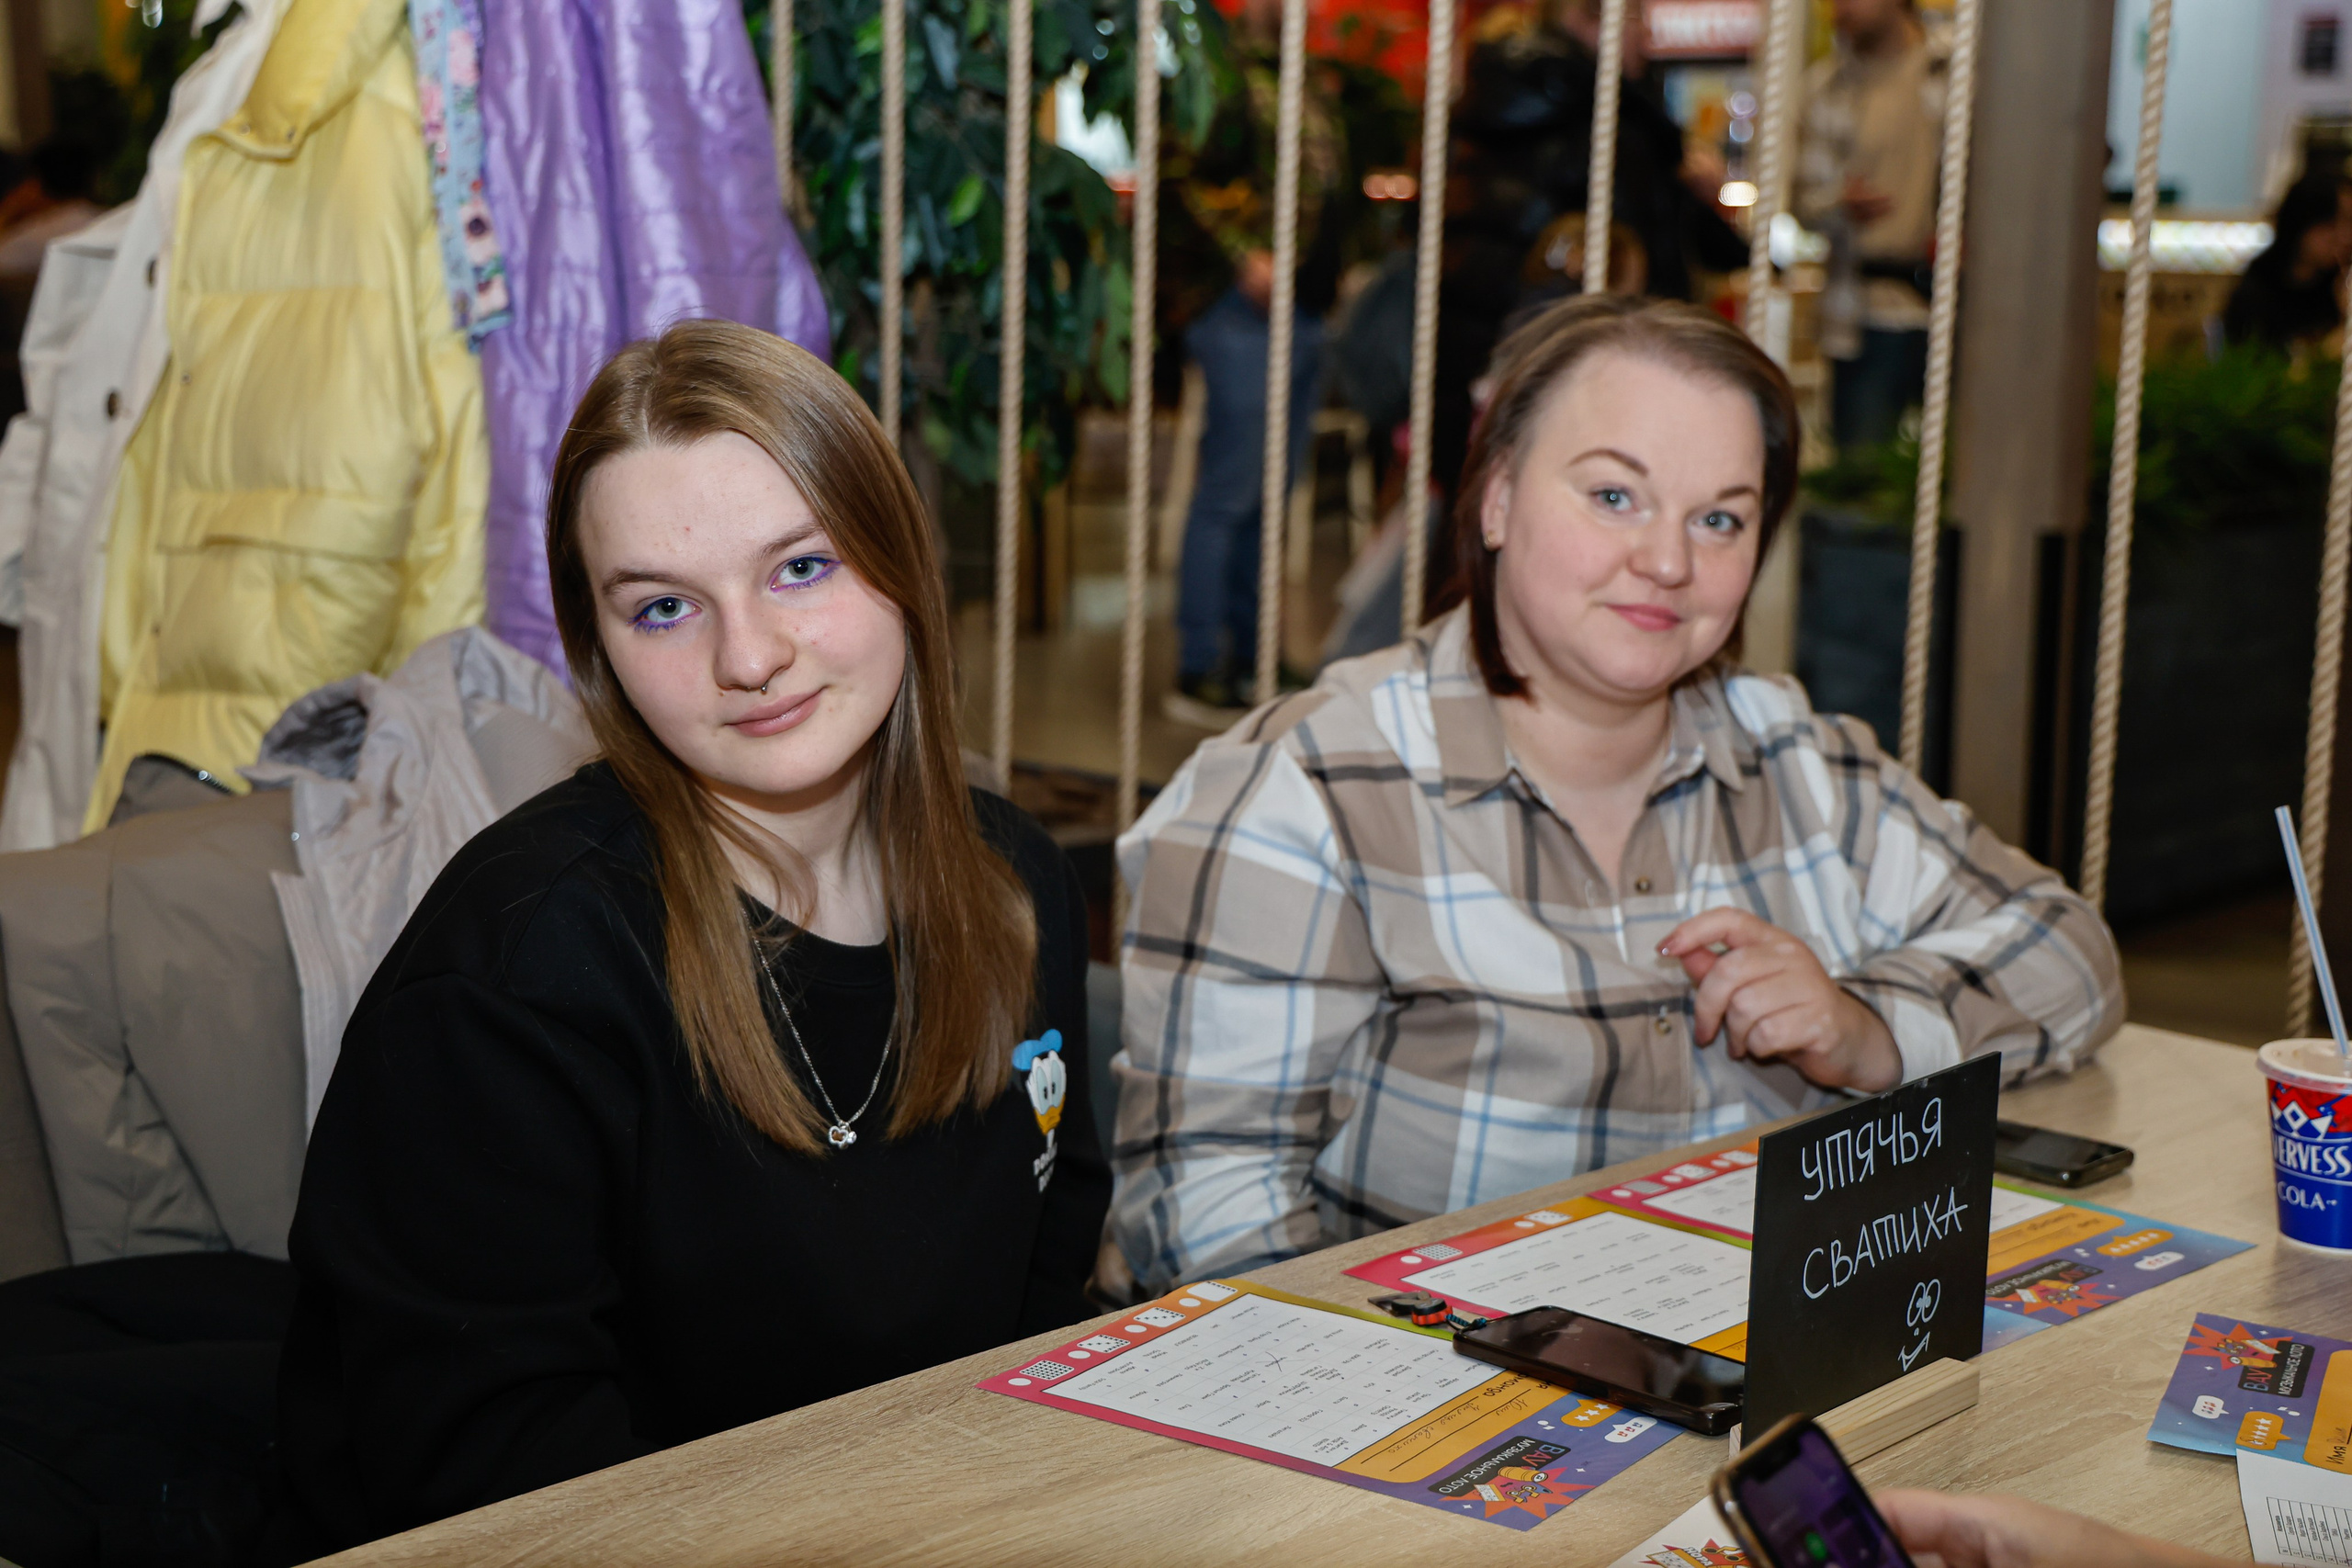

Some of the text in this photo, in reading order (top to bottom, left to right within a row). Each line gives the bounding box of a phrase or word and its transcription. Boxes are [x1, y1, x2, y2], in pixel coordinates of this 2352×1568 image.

[2278, 1181, 2326, 1212] COLA
[1803, 1186, 1968, 1299] СВАТИХА
[2290, 1343, 2306, 1359] ЛОТО
[1439, 1438, 1536, 1494] МУЗЫКАЛЬНОЕ ЛОТО
[1521, 1444, 1566, 1467] ВАУ
[2325, 1445, 2347, 1466] Имя
